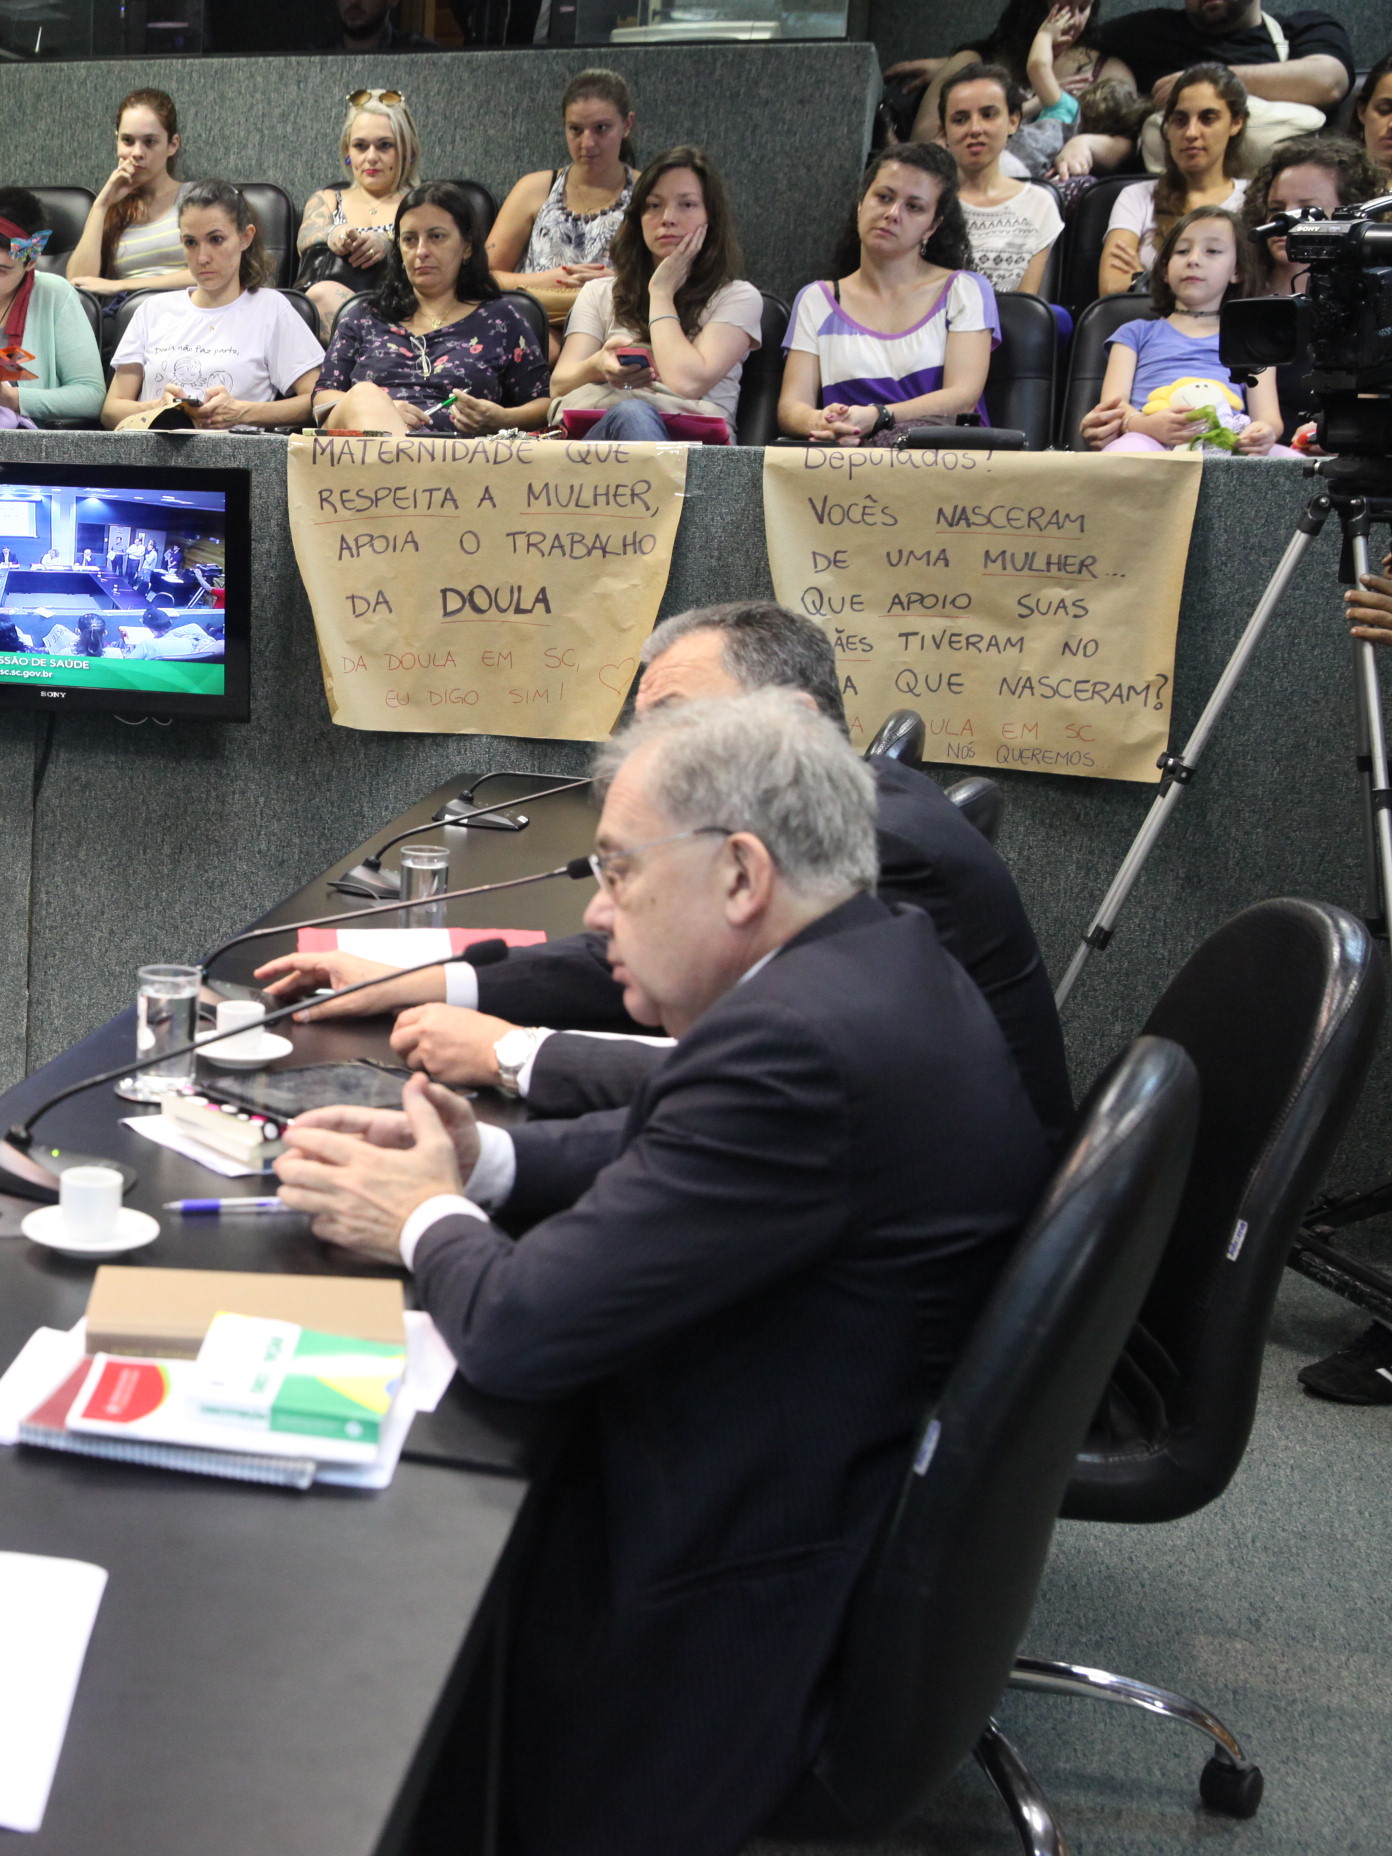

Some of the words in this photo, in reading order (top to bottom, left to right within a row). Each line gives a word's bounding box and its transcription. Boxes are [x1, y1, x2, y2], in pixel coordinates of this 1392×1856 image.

[312, 436, 534, 467] MATERNIDADE
[565, 438, 632, 466] QUE
[318, 485, 460, 514] RESPEITA
[477, 484, 497, 509] A
[526, 479, 660, 518] MULHER,
[808, 494, 899, 527] VOCÊS
[935, 505, 1086, 532] NASCERAM
[338, 530, 420, 561] APOIA
[459, 530, 481, 555] O
[506, 530, 657, 560] TRABALHO
[812, 550, 851, 574] DE
[885, 549, 951, 569] UMA
[345, 590, 393, 618] DA
[440, 584, 552, 618] DOULA
[800, 586, 866, 618] QUE
[886, 592, 973, 615] APOIO
[1016, 593, 1090, 620] SUAS
[833, 627, 874, 653] ÃES
[897, 630, 1025, 655] TIVERAM
[1061, 637, 1101, 659] NO
[30, 657, 47, 668] DE
[49, 658, 90, 670] SAÚDE
[341, 656, 368, 674] DA
[384, 651, 457, 671] DOULA
[481, 651, 514, 669] EM
[40, 691, 66, 699] SONY
[385, 690, 411, 708] EU
[428, 688, 480, 706] DIGO
[894, 668, 966, 698] QUE
[998, 673, 1170, 713] NASCERAM?
[929, 717, 975, 737] ULA
[1001, 723, 1039, 741] EM
[1065, 723, 1097, 743] SC
